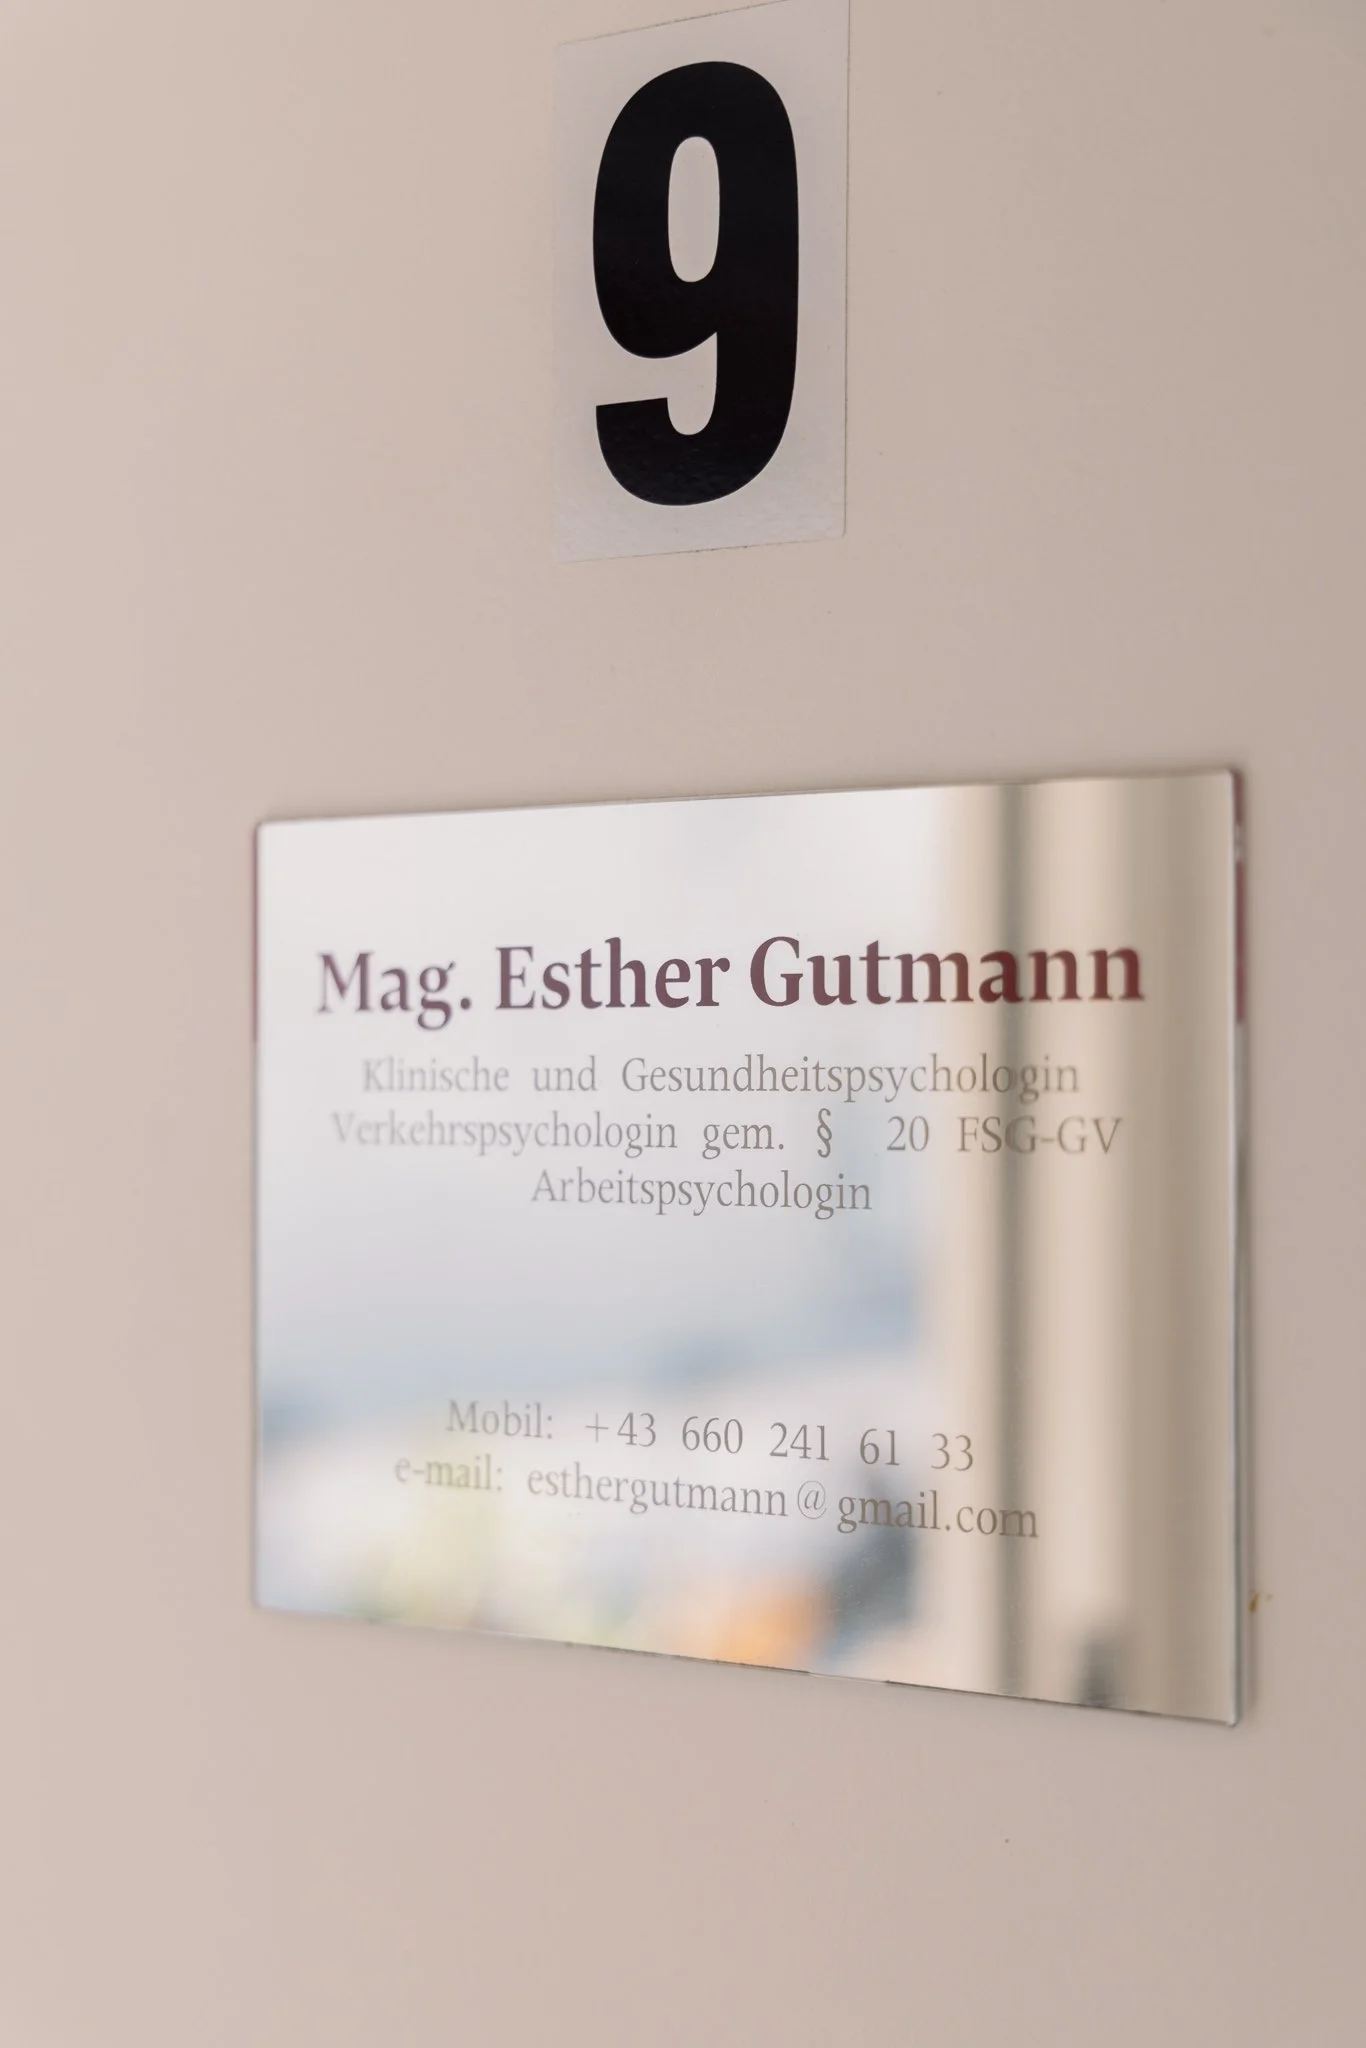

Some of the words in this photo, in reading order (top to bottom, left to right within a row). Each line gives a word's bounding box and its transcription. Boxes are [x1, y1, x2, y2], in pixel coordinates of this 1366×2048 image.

[593, 61, 798, 506] 9
[316, 950, 473, 1031] Mag.
[495, 937, 731, 1010] Esther
[750, 936, 1145, 1007] Gutmann
[361, 1055, 510, 1094] Klinische
[532, 1055, 599, 1093] und
[621, 1052, 1081, 1104] Gesundheitspsychologin
[329, 1109, 679, 1159] Verkehrspsychologin
[702, 1122, 785, 1160] gem.
[816, 1108, 833, 1158] §
[886, 1116, 930, 1152] 20
[957, 1115, 1123, 1154] FSG-GV
[531, 1166, 873, 1220] Arbeitspsychologin
[446, 1399, 554, 1440] Mobil:
[584, 1411, 657, 1448] +43
[681, 1415, 744, 1454] 660
[768, 1422, 830, 1461] 241
[858, 1428, 900, 1466] 61
[930, 1432, 974, 1472] 33
[394, 1453, 503, 1492] e-mail:
